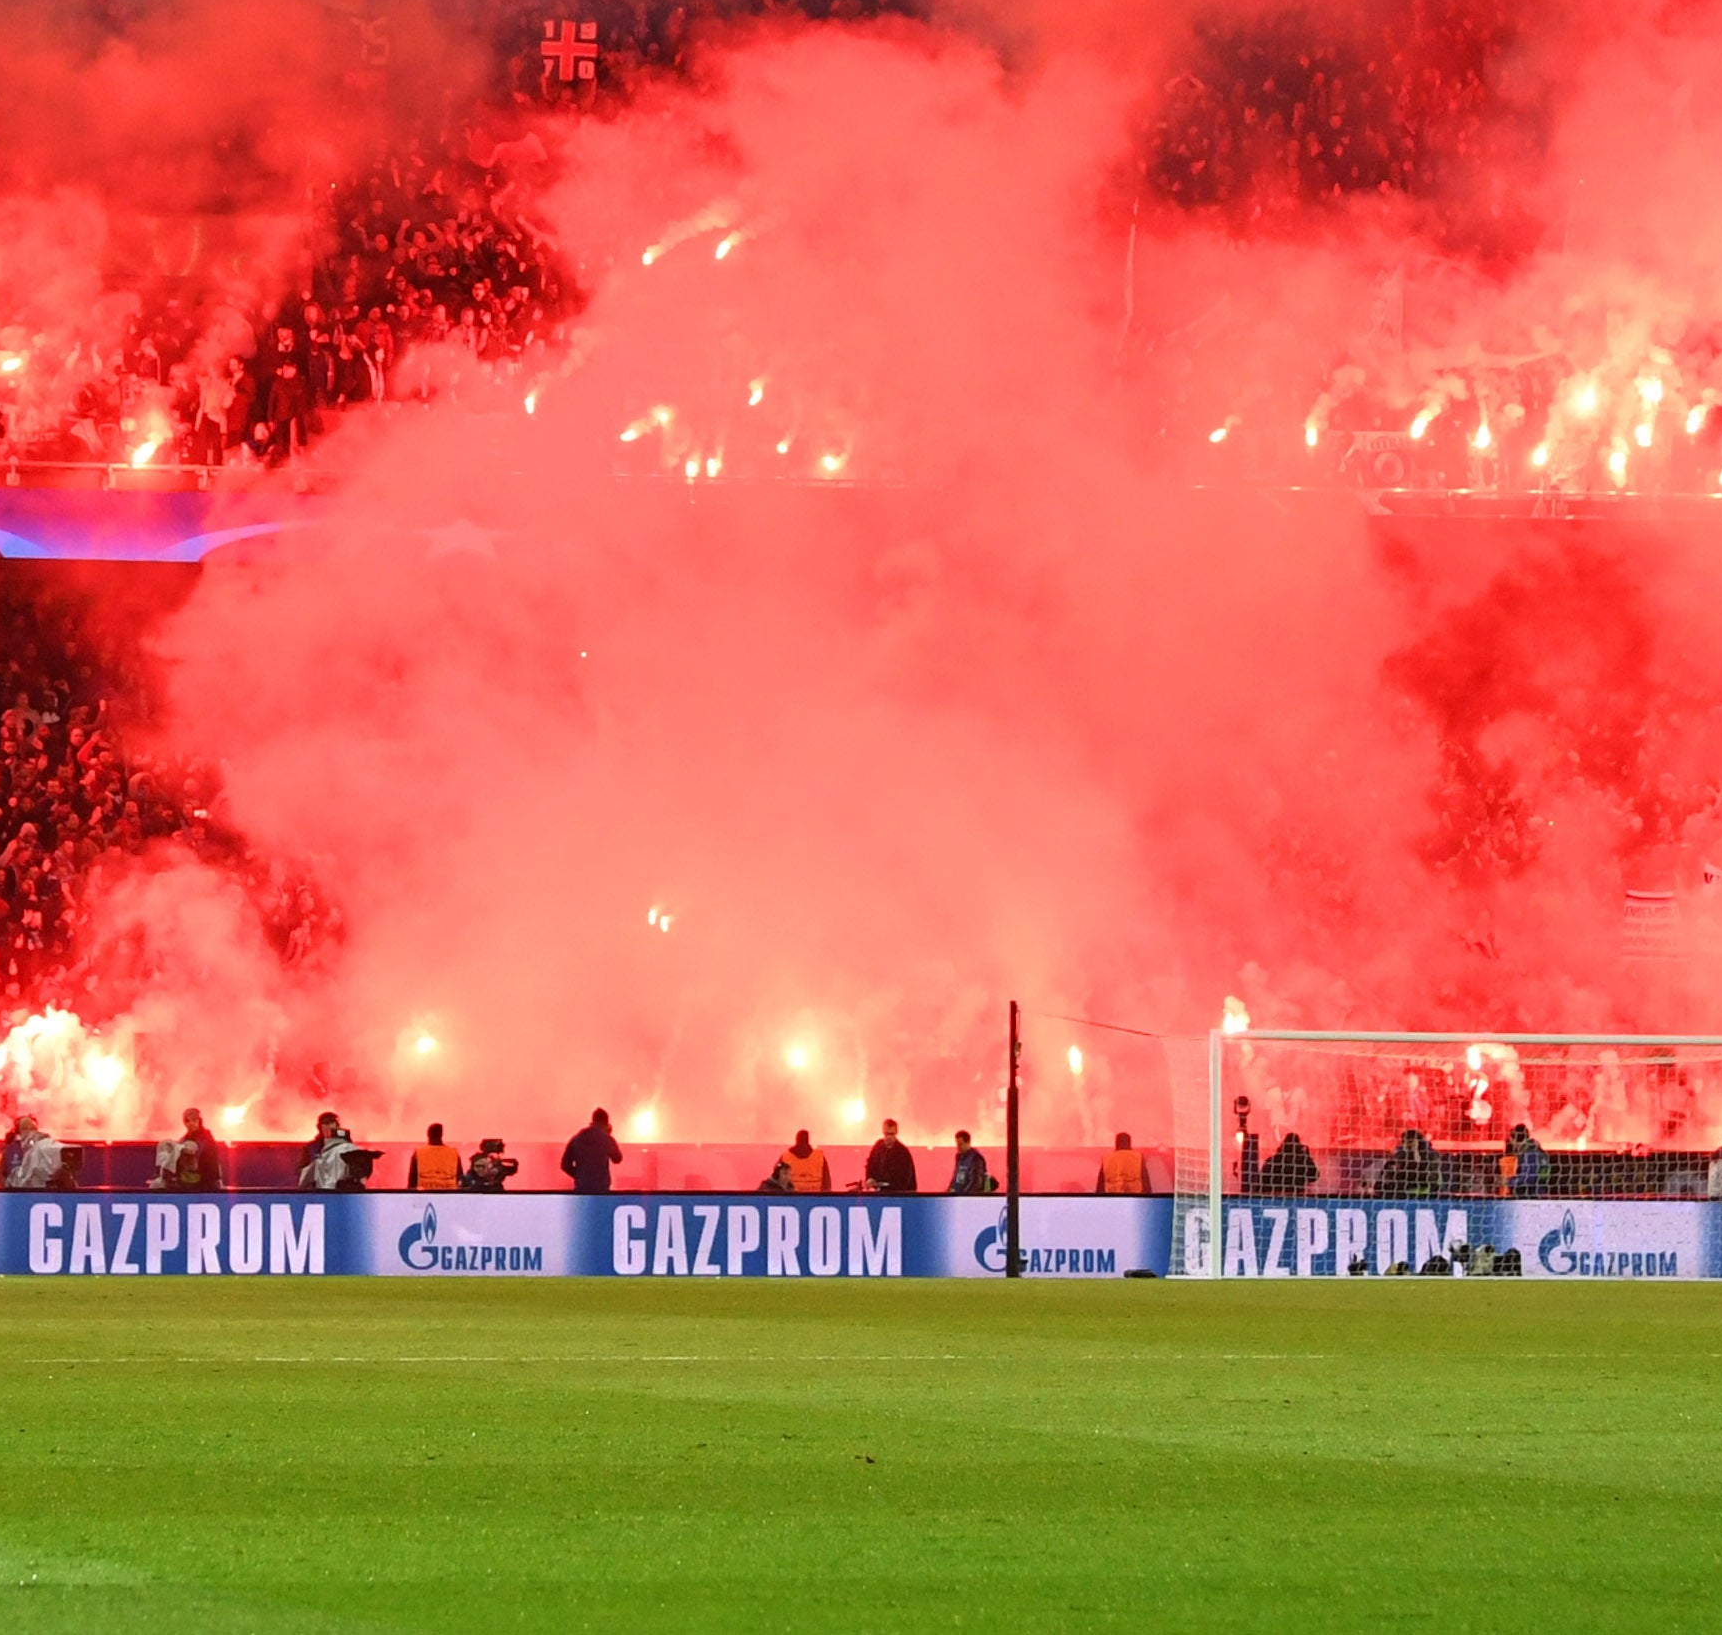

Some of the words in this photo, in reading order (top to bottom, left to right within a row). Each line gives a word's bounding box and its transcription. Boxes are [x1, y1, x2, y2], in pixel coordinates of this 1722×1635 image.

[29, 1203, 324, 1274] GAZPROM
[442, 1246, 542, 1271] GAZPROM
[614, 1205, 901, 1276] GAZPROM
[1184, 1208, 1468, 1276] GAZPROM
[1580, 1252, 1677, 1276] GAZPROM
